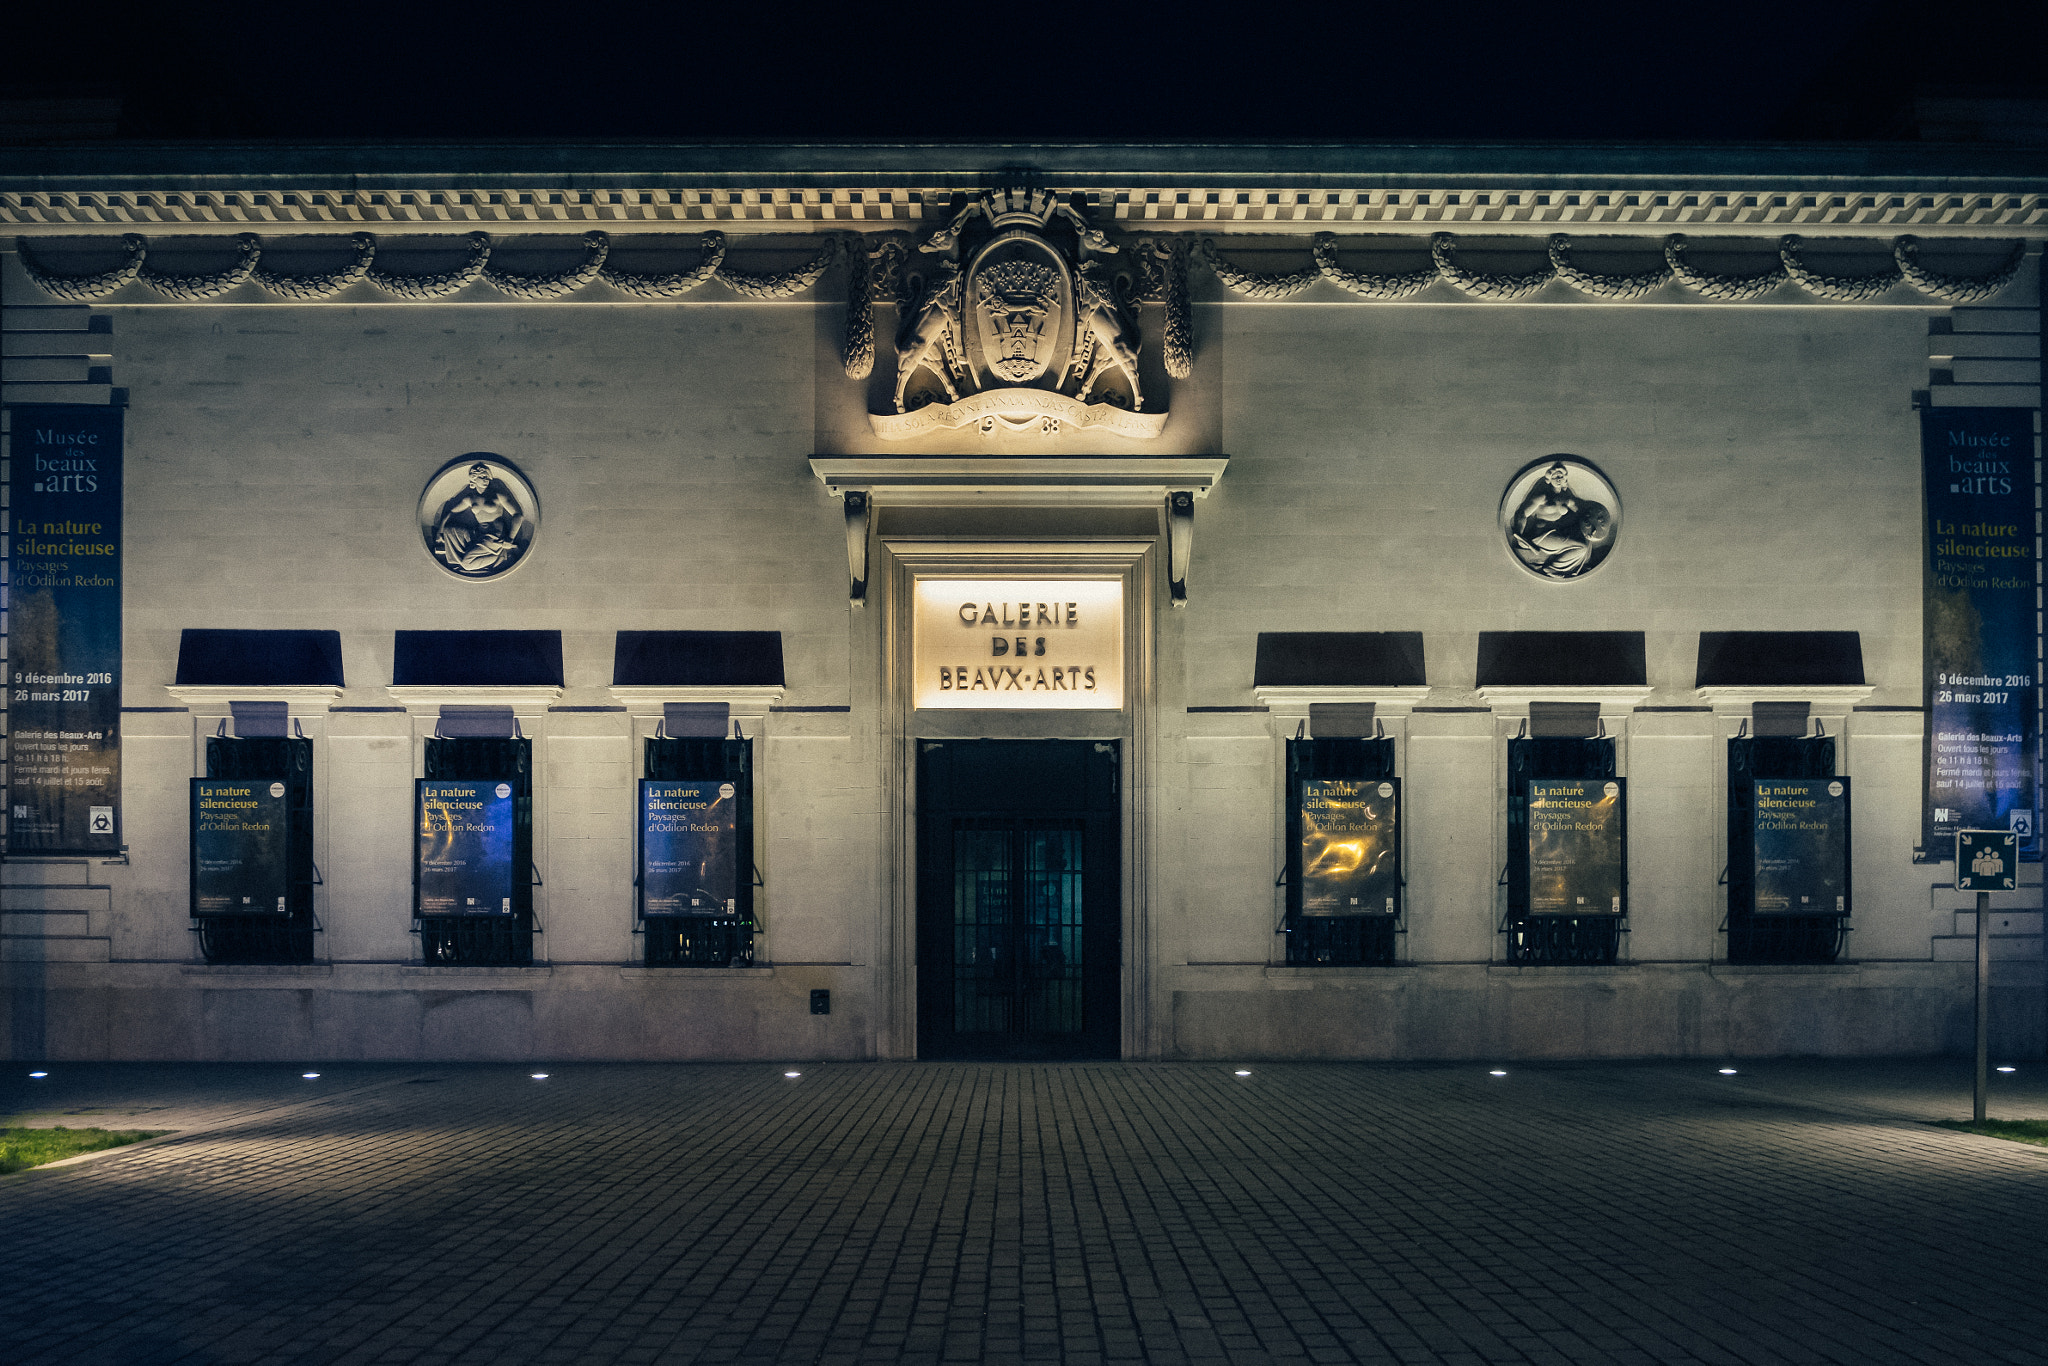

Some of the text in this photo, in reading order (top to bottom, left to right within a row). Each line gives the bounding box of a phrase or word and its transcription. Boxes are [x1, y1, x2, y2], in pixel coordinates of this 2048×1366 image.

[36, 429, 98, 445] Musée
[1948, 430, 2011, 447] Musée
[65, 447, 85, 457] des
[1977, 449, 1997, 459] des
[35, 453, 97, 472] beaux
[1949, 454, 2010, 474] beaux
[18, 519, 102, 535] La nature
[1936, 519, 2018, 537] La nature
[17, 538, 115, 556] silencieuse
[1936, 538, 2030, 558] silencieuse
[17, 559, 69, 574] Paysages
[1937, 559, 1985, 575] Paysages
[16, 574, 114, 587] d'Odilon Redon
[1992, 576, 2030, 589] Redon
[959, 602, 1079, 625] GALERIE
[991, 637, 1046, 657] DES
[14, 671, 112, 685] 9 décembre 2016
[1939, 673, 2030, 687] 9 décembre 2016
[14, 690, 90, 702] 26 mars 2017
[1939, 691, 2009, 704] 26 mars 2017
[14, 730, 103, 740] Galerie des Beaux-Arts
[1938, 732, 2023, 742] Galerie des Beaux-Arts
[14, 742, 39, 751] Ouvert
[69, 743, 89, 752] jours
[200, 786, 251, 797] La nature
[425, 787, 476, 797] La nature
[648, 787, 700, 798] La nature
[1307, 786, 1359, 797] La nature
[1534, 786, 1584, 796] La nature
[1758, 785, 1809, 795] La nature
[200, 798, 258, 809] silencieuse
[425, 799, 483, 810] silencieuse
[648, 799, 707, 810] silencieuse
[1306, 798, 1366, 809] silenieuse
[1758, 797, 1816, 808] silencieuse
[200, 811, 238, 822] Paysages
[648, 812, 686, 823] Paysages
[1307, 811, 1346, 822] Paysages
[1533, 811, 1571, 822] Paysages
[1758, 810, 1796, 821] Paysages
[200, 822, 270, 831] d'Odilon Redon
[425, 823, 495, 832] d'Odon Redon
[648, 823, 719, 832] d'Odilon Redon
[1306, 822, 1378, 831] d'Odilon Redon
[1533, 822, 1603, 831] d'Odilon Redon
[1758, 821, 1828, 830] d'Odilon Redon
